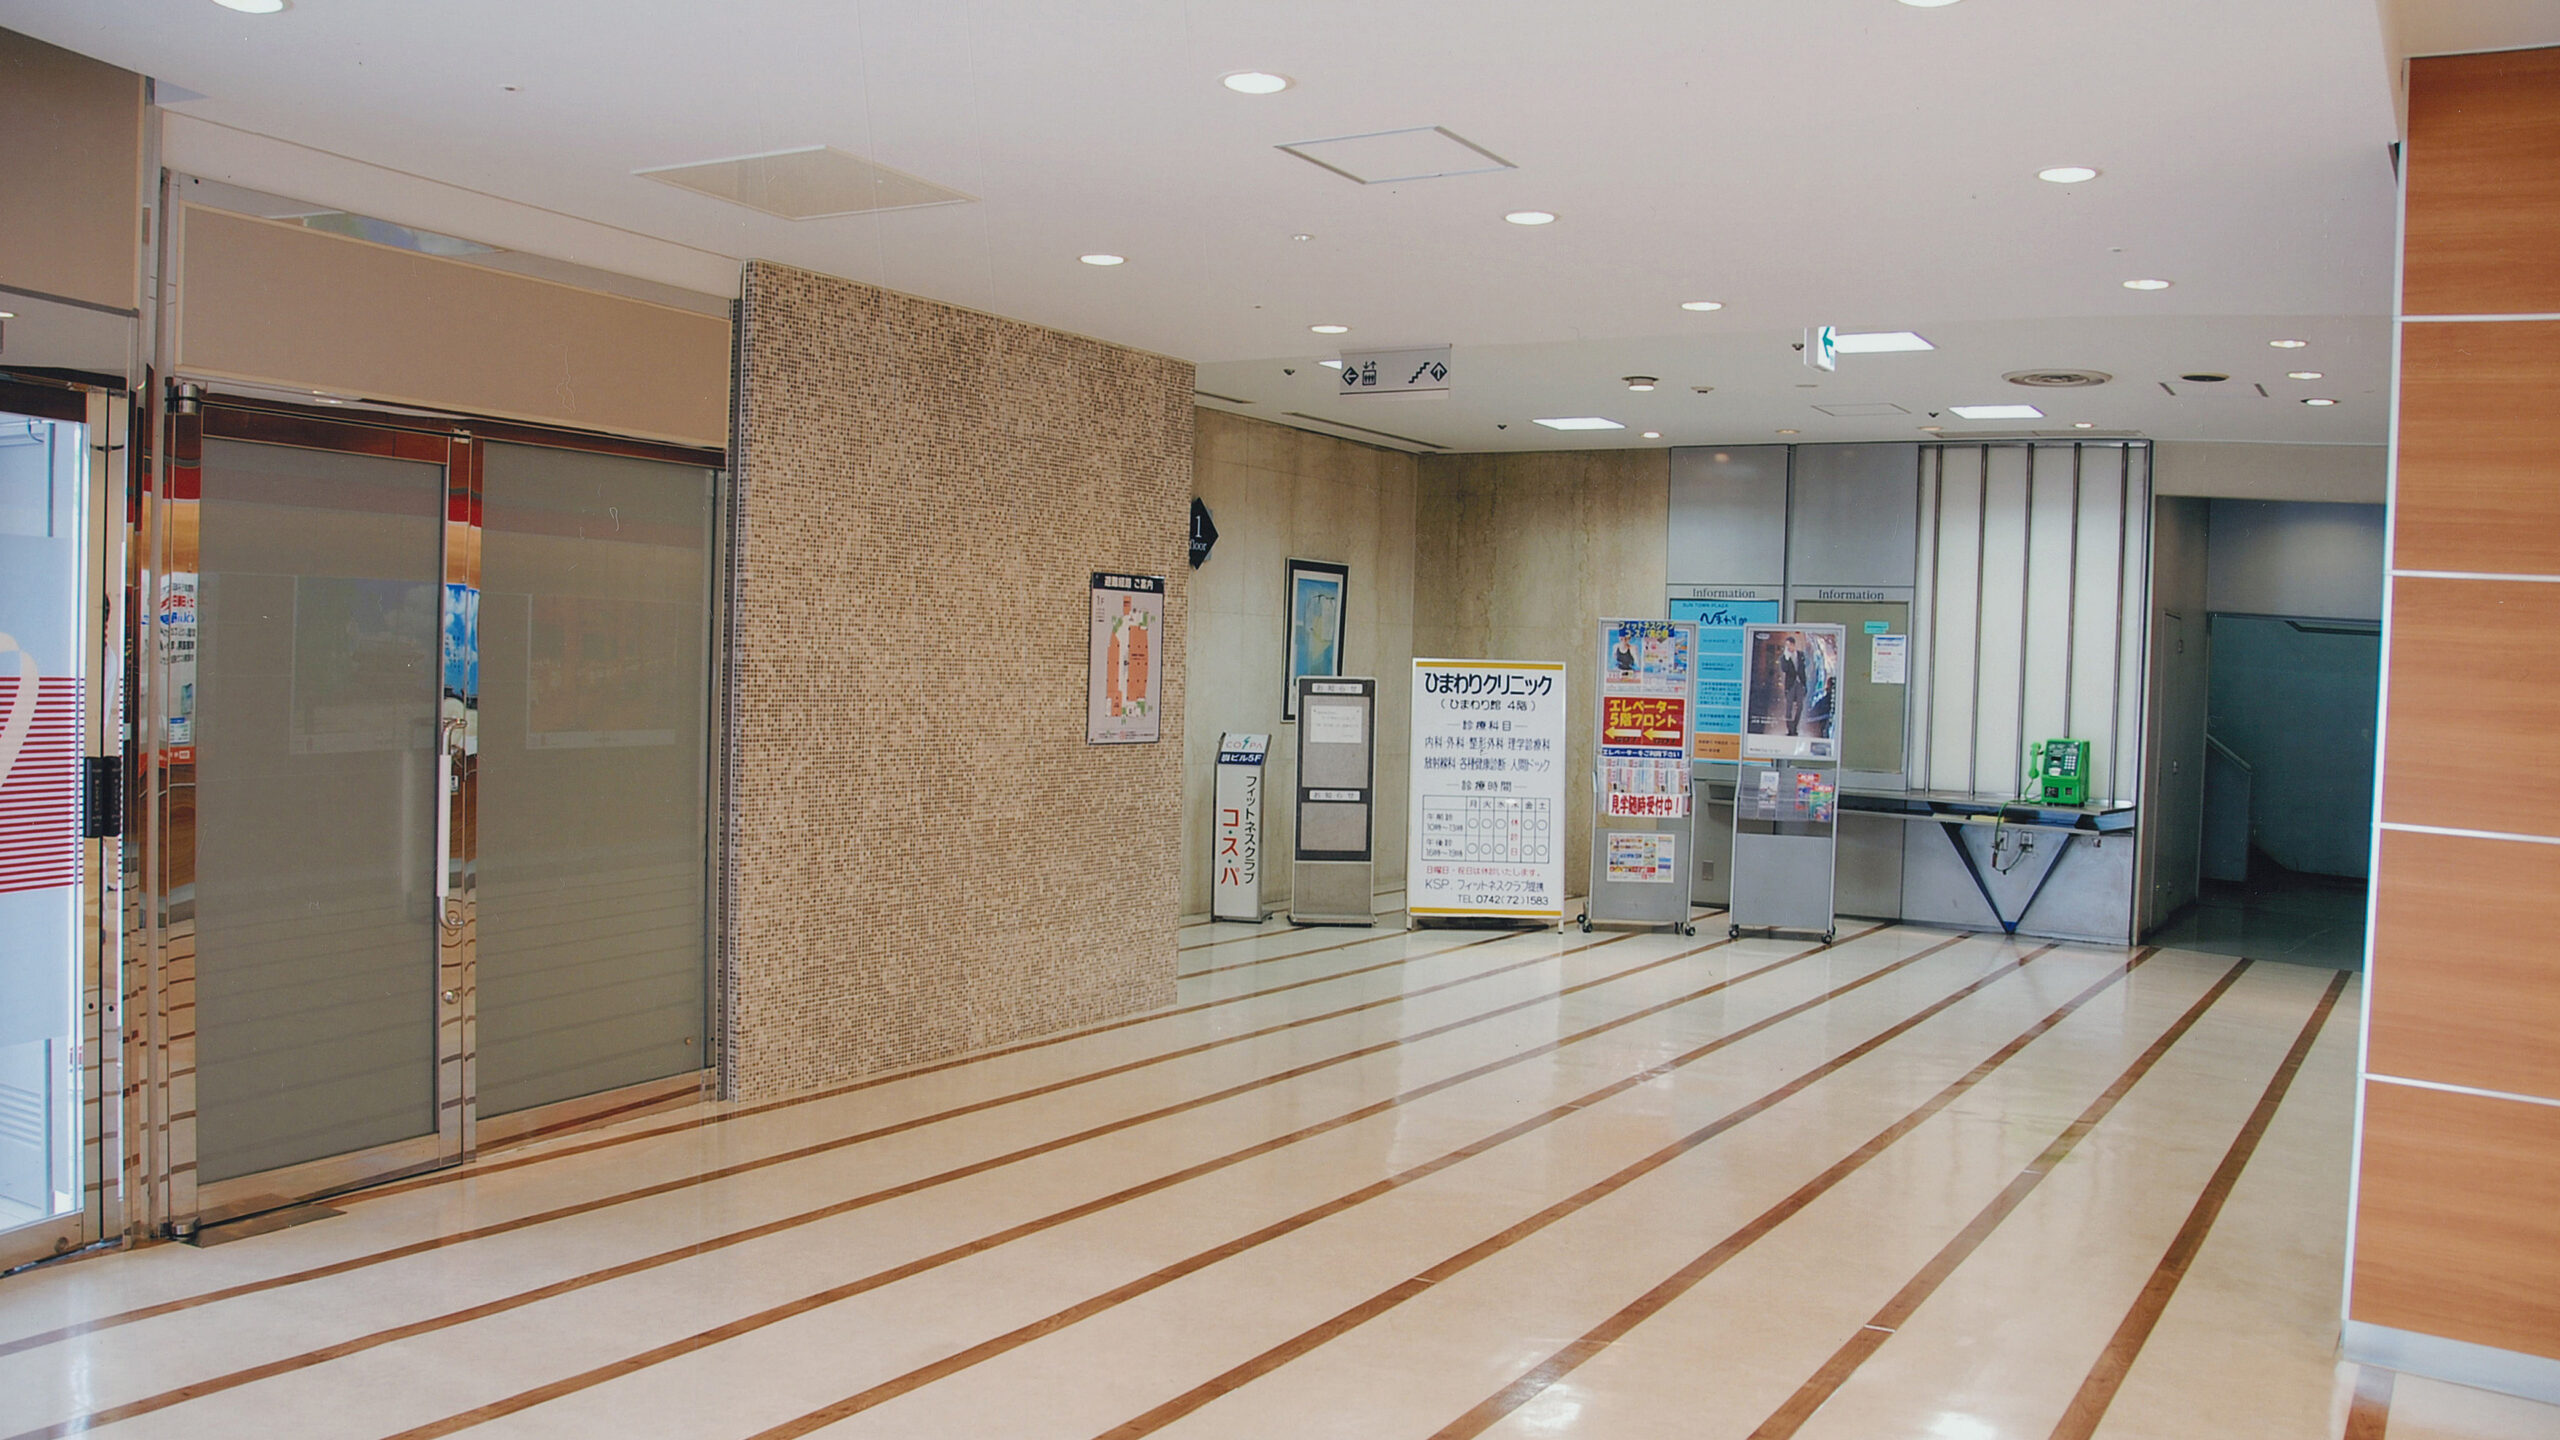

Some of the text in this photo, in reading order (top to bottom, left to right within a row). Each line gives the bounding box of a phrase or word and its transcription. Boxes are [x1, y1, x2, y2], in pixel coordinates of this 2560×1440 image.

[1195, 515, 1202, 537] 1
[1692, 588, 1756, 598] Information
[1818, 589, 1885, 600] Information
[1424, 672, 1552, 696] ひまわりクリニック
[1609, 699, 1679, 713] エレベーター
[1462, 719, 1512, 732] 診療科目
[1609, 713, 1677, 728] 5階フロント
[1424, 736, 1442, 749] 内科
[1446, 736, 1464, 749] 外科
[1469, 737, 1504, 750] 整形外科
[1424, 756, 1456, 769] 放射線科
[1461, 780, 1512, 792] 診療時間
[1469, 800, 1477, 808] 月
[1525, 801, 1533, 809] 金
[1539, 801, 1546, 809] 土
[1244, 776, 1257, 884] フィットネスクラブ
[1458, 894, 1549, 906] TEL 0742(72)1583
